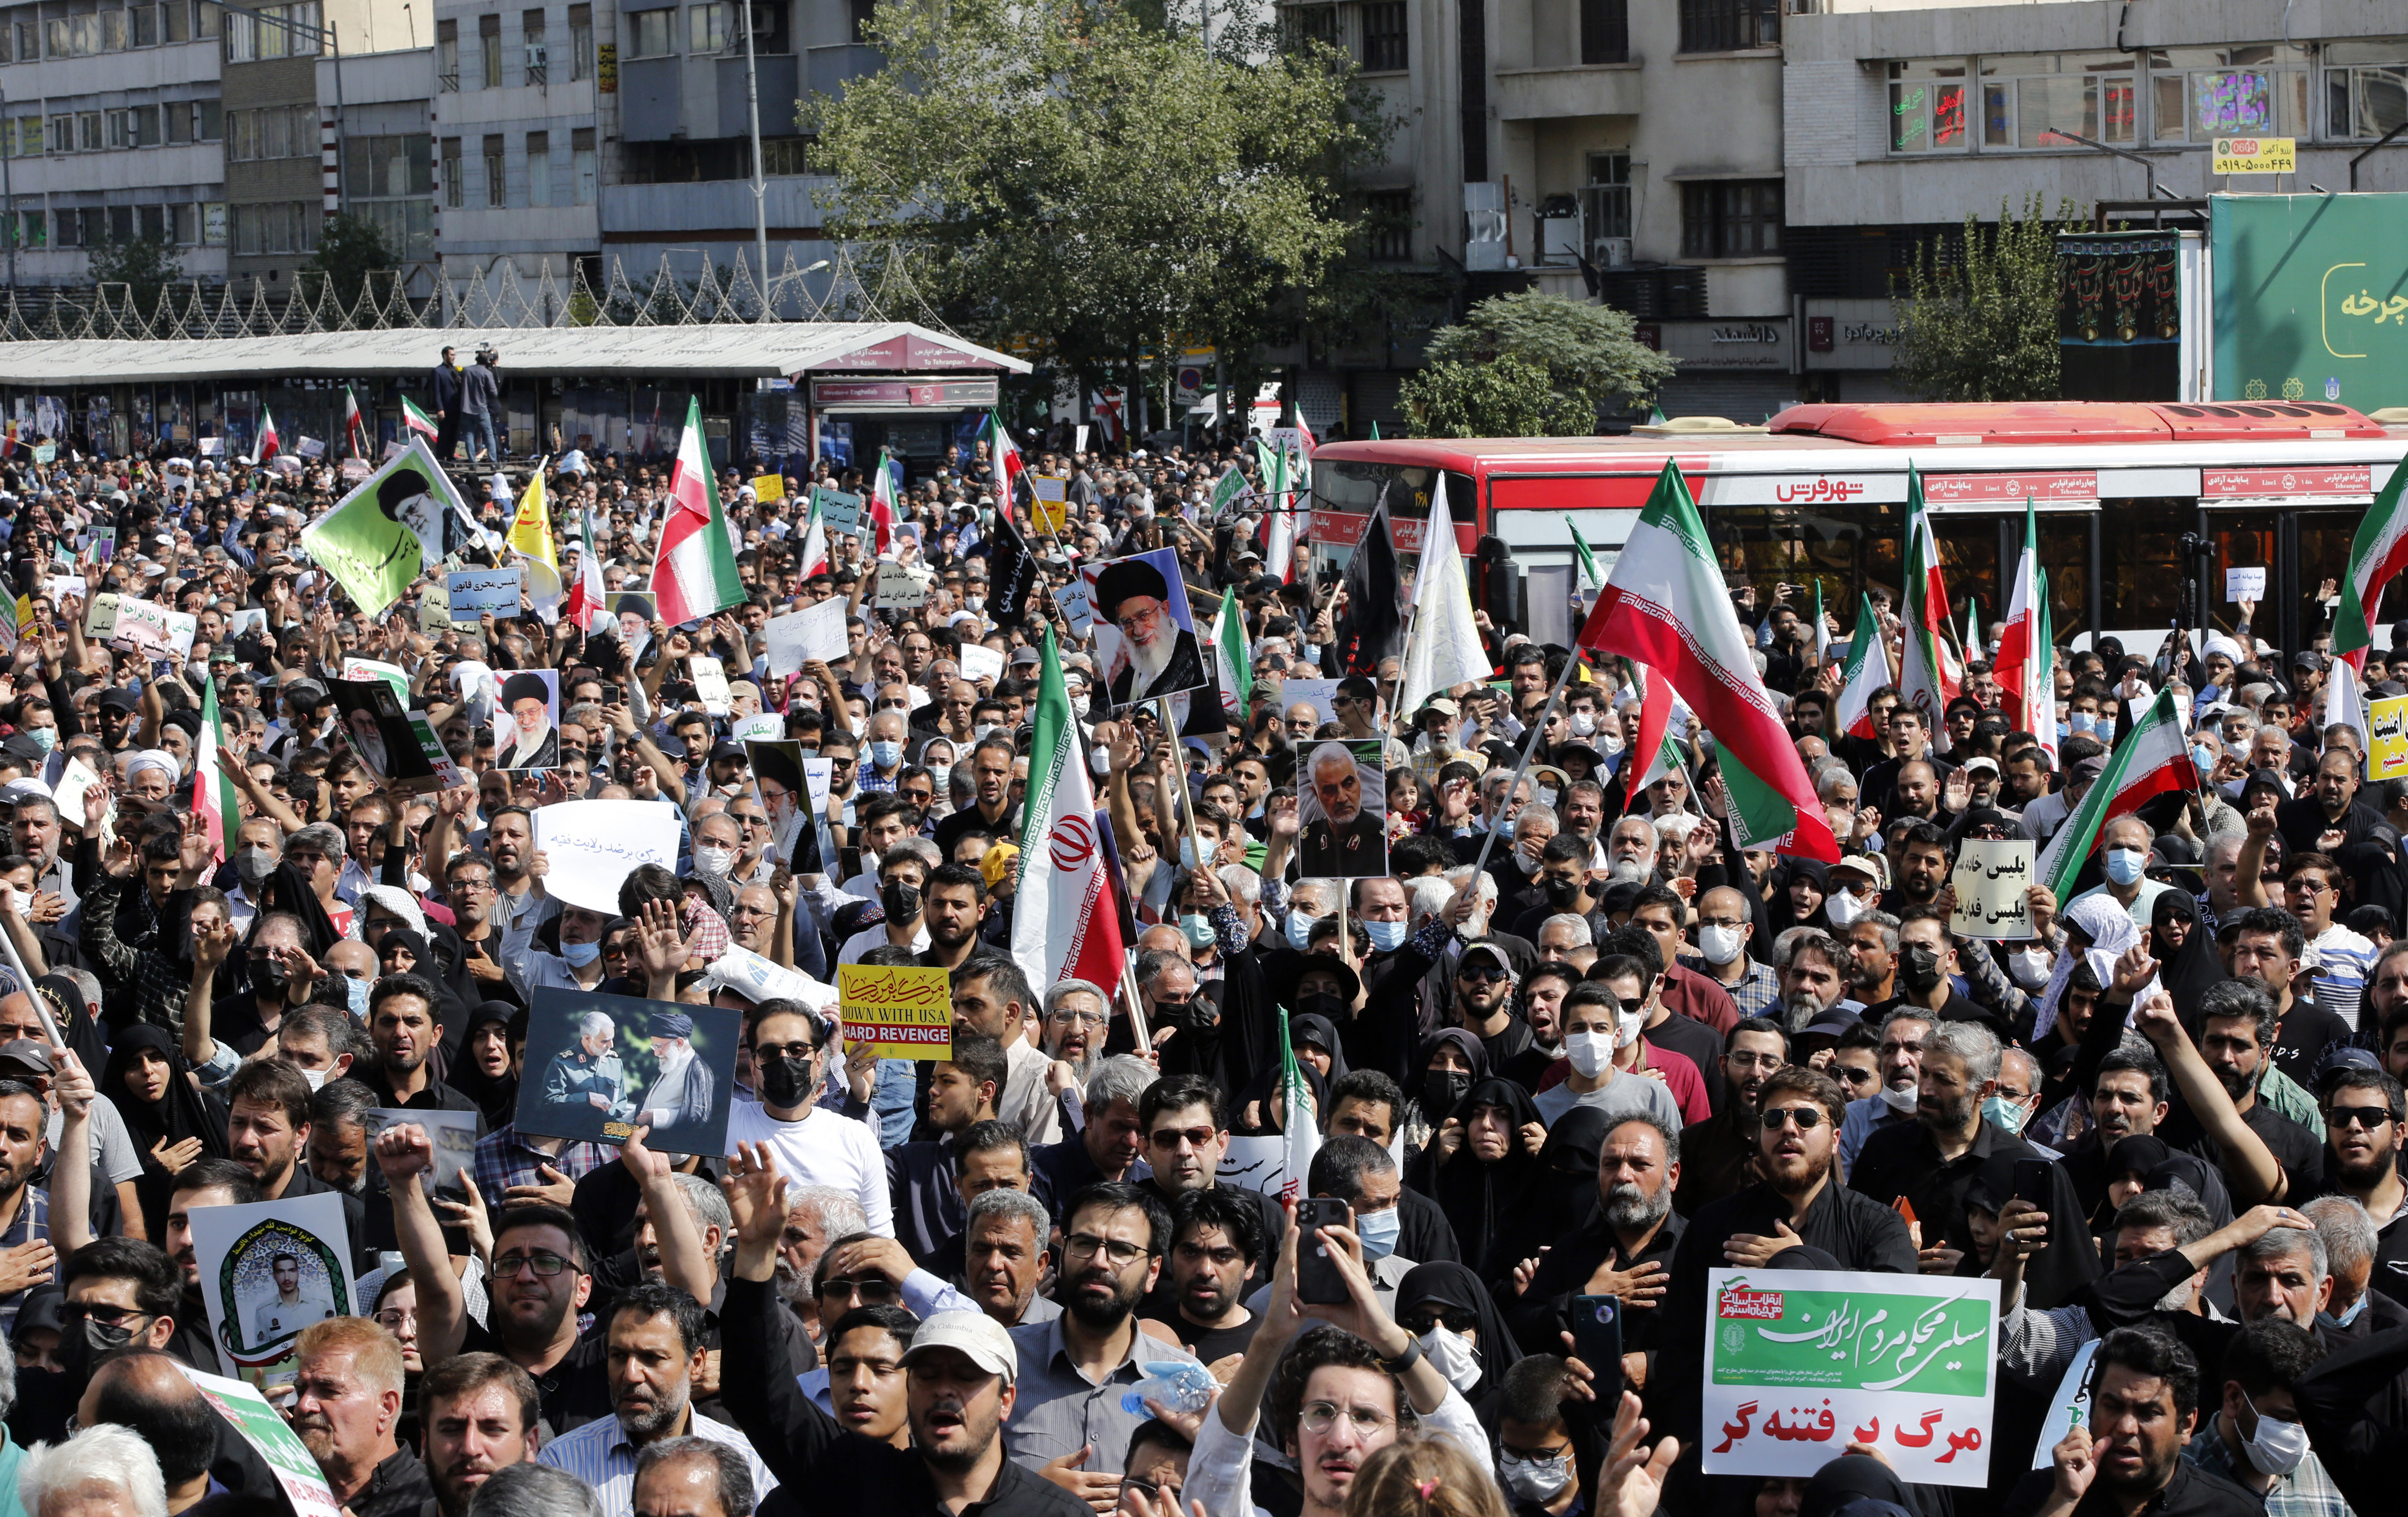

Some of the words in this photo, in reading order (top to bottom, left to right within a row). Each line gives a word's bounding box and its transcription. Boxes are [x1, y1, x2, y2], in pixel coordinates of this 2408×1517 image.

[1894, 88, 1924, 115] عربی
[2233, 143, 2256, 152] 0604
[2280, 146, 2291, 155] رزرو
[1711, 325, 1776, 343] دانشمند
[1929, 481, 1948, 491] آزادی
[2208, 475, 2227, 486] آزادی
[452, 579, 472, 592] قانون
[473, 581, 496, 592] مجری
[497, 577, 517, 589] پلیس
[476, 601, 496, 613] خادم
[496, 599, 516, 611] پلیس
[18, 620, 36, 634] REVENGE
[91, 621, 112, 633] تشکر
[427, 619, 449, 630] تشکر
[452, 624, 477, 635] تشکر
[736, 722, 775, 742] انتظامی
[2374, 705, 2403, 745] امنیت
[2383, 752, 2405, 772] هستیم
[807, 768, 824, 779] مهسا
[811, 790, 824, 799] اصل
[551, 833, 571, 848] فقیه
[573, 837, 602, 852] ولایت
[604, 841, 623, 854] ضد
[622, 849, 633, 859] بر
[1964, 854, 1982, 877] خادم
[1986, 855, 2025, 880] پلیس
[1986, 899, 2025, 925] پلیس
[842, 1006, 873, 1021] DOWN
[878, 1008, 913, 1022] WITH
[920, 1010, 946, 1023] USA
[843, 1025, 876, 1040] HARD
[880, 1027, 949, 1042] REVENGE
[276, 1225, 298, 1235] قوامین
[1750, 1293, 1782, 1306] انقلاب
[1720, 1303, 1751, 1316] استوار
[1750, 1303, 1782, 1319] همچنان
[1757, 1298, 1860, 1362] ایران
[1896, 1289, 1969, 1375] محکم
[1855, 1309, 1907, 1368] مردم
[1861, 1320, 1986, 1391] سیلی
[1712, 1400, 1759, 1453] گر
[1762, 1398, 1836, 1442] فتنه
[1894, 1408, 1982, 1463] مرگ
